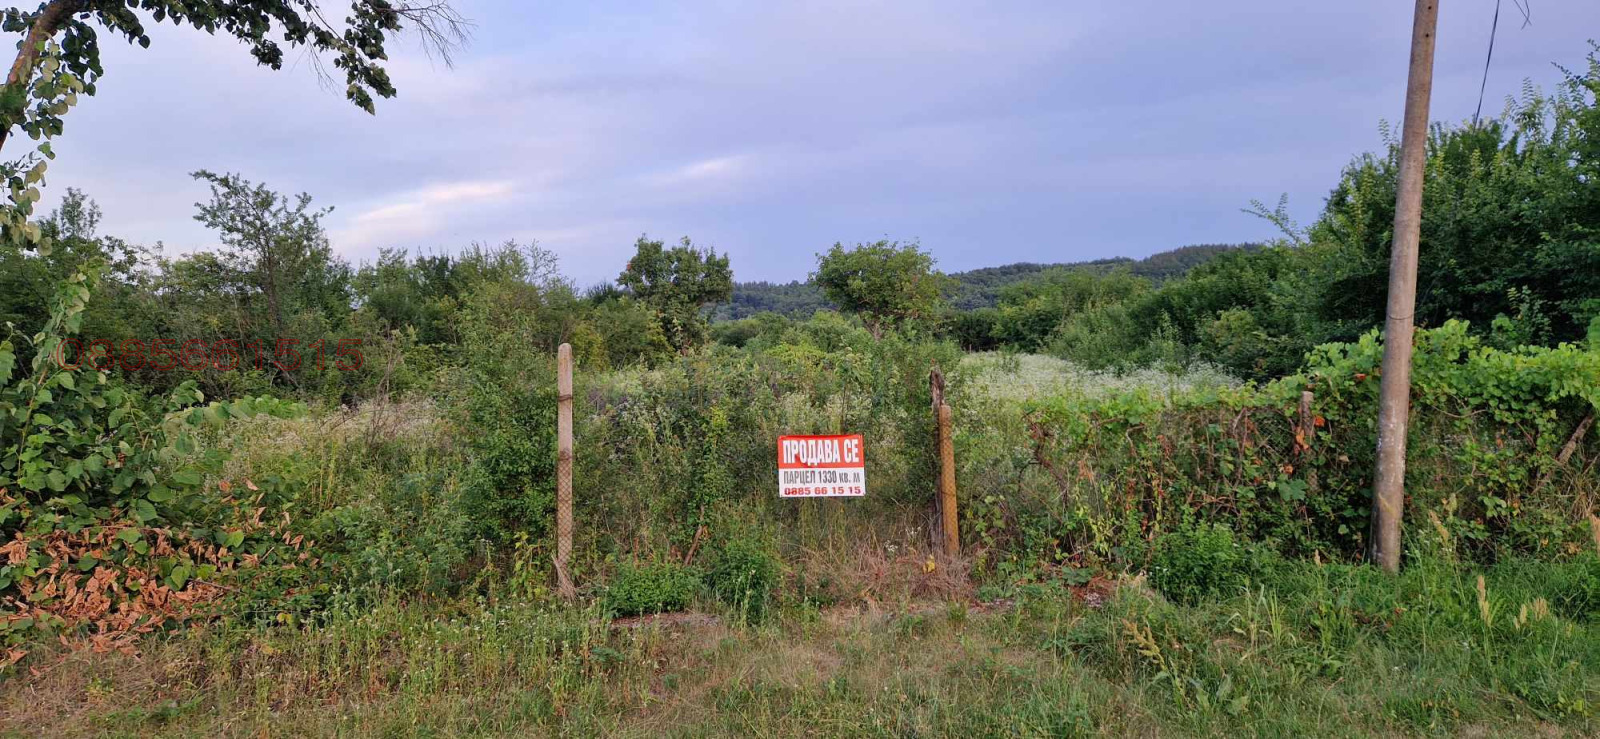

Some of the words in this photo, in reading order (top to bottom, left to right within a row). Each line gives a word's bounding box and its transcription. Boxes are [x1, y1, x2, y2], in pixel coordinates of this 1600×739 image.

[783, 439, 841, 466] ПРОДАВА
[844, 439, 859, 463] СЕ
[783, 470, 816, 485] ПАРЦЕЛ
[818, 470, 837, 483] 1330
[784, 487, 811, 495] 0885
[814, 486, 828, 495] 66
[831, 486, 845, 495] 15
[848, 486, 861, 494] 15
